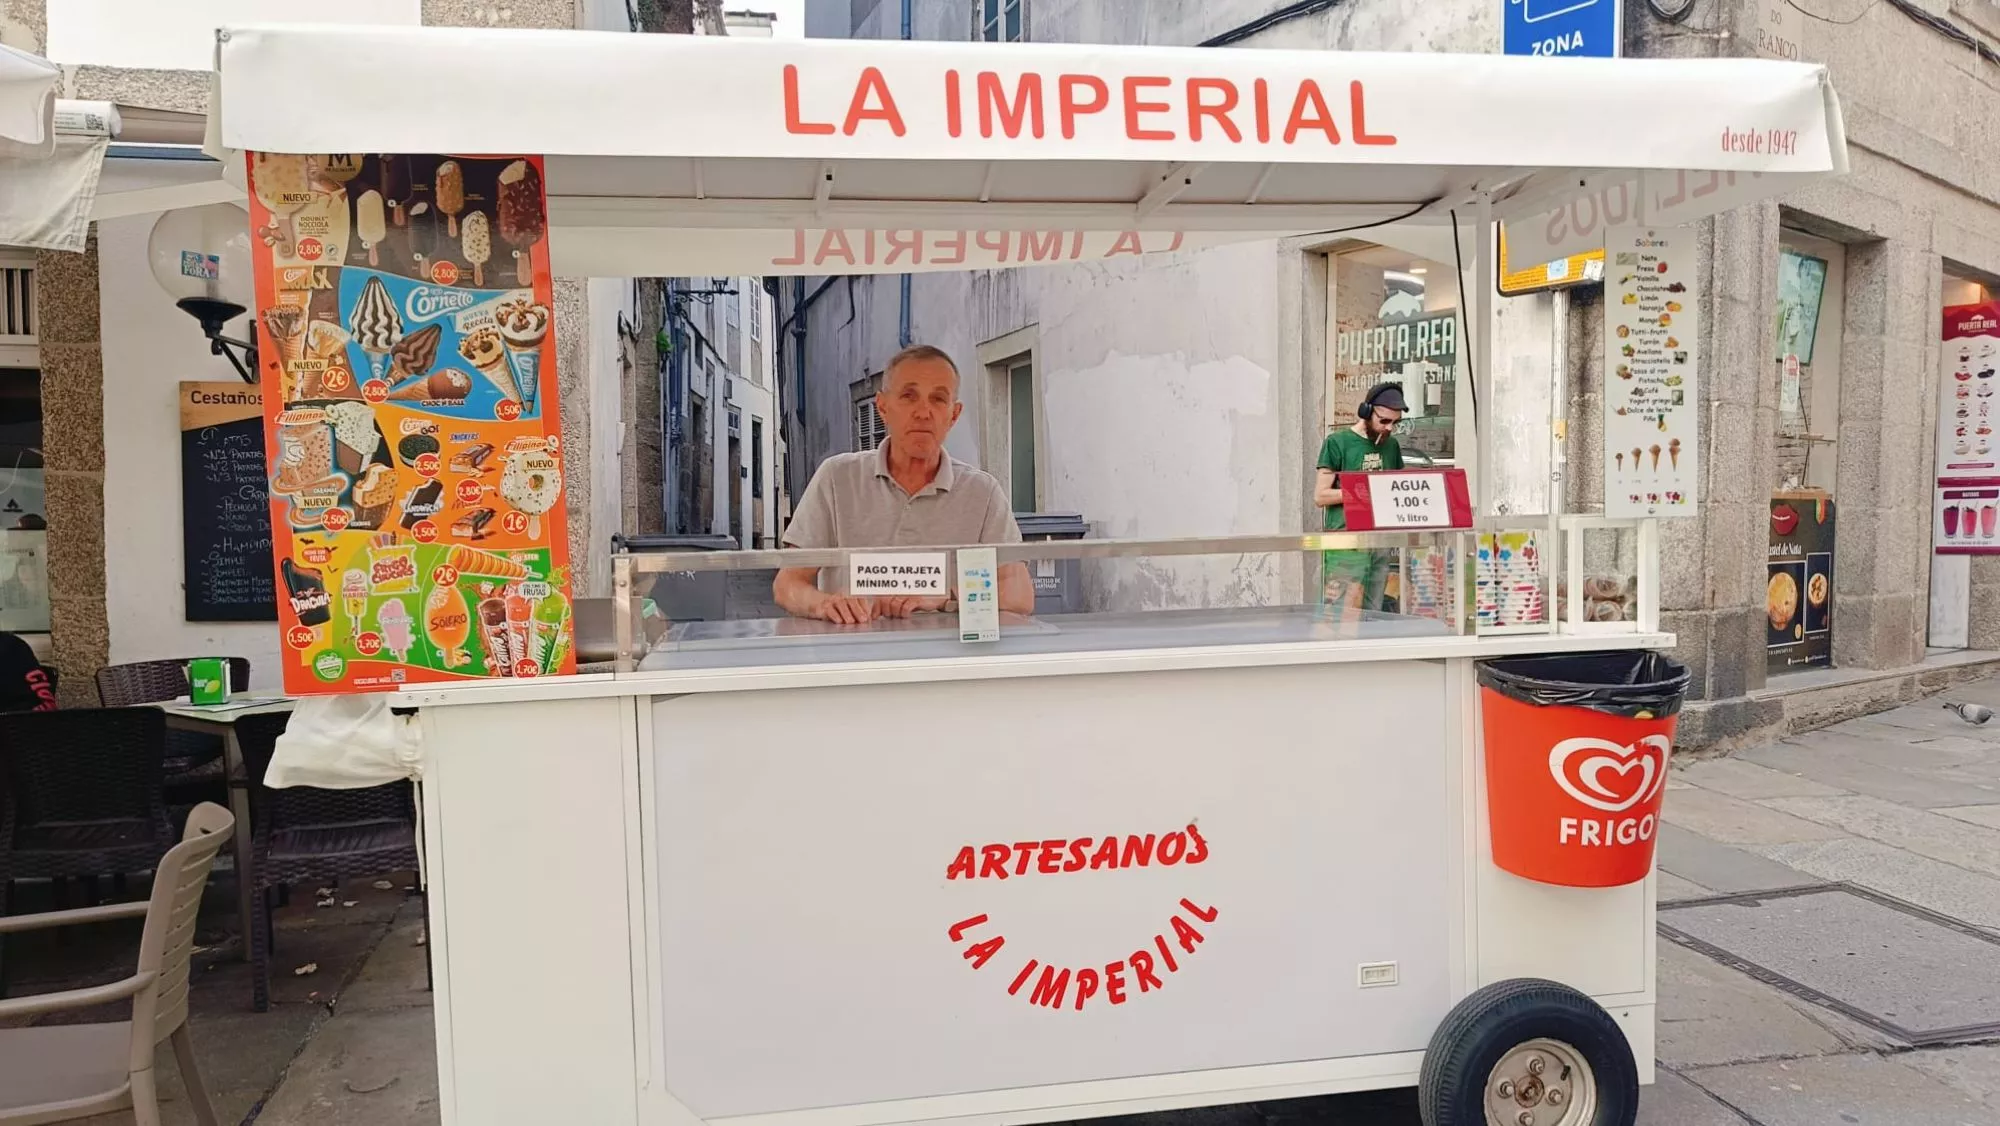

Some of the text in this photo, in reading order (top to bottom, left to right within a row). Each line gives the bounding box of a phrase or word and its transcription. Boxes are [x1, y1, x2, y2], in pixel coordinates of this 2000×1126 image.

[1531, 29, 1584, 56] ZONA
[783, 64, 1397, 146] LA IMPERIAL
[1722, 126, 1797, 156] desde 1947
[282, 193, 311, 203] NUEVO
[298, 245, 323, 255] 2,80€
[1636, 264, 1655, 273] Fresa
[433, 269, 457, 280] 2,80€
[1641, 294, 1659, 302] Limón
[405, 286, 474, 323] Cornetto
[1638, 304, 1665, 314] Naranja
[463, 317, 494, 333] Receta
[1631, 328, 1669, 337] Tutti-frutti
[1337, 323, 1409, 368] PUERTA
[1636, 348, 1663, 356] Avellana
[293, 361, 322, 371] NUEVO
[326, 370, 345, 388] 2€
[364, 388, 387, 398] 2,80€
[1643, 386, 1659, 395] Café
[496, 404, 520, 416] 1,50€
[416, 461, 439, 471] 2,50€
[526, 460, 554, 469] NUEVO
[458, 486, 481, 496] 2,80€
[1390, 480, 1431, 492] AGUA
[303, 497, 332, 507] NUEVO
[1393, 496, 1429, 508] 1.00 €
[323, 513, 348, 525] 2,50€
[506, 516, 525, 531] 1€
[1406, 513, 1428, 523] litro
[415, 527, 438, 538] 1,50€
[436, 567, 455, 585] 2€
[857, 565, 941, 576] PAGO TARJETA
[856, 578, 899, 589] MÍNIMO
[914, 580, 927, 589] 50
[930, 580, 937, 589] €
[523, 588, 546, 597] FRUTAS
[429, 613, 467, 631] SOLERO
[290, 633, 313, 644] 1,50€
[358, 639, 381, 649] 1,70€
[517, 665, 538, 675] 1,70€
[1559, 816, 1655, 847] FRIGO
[946, 823, 1210, 881] ARTESANOS
[947, 896, 1219, 1012] LA IMPERIAL
